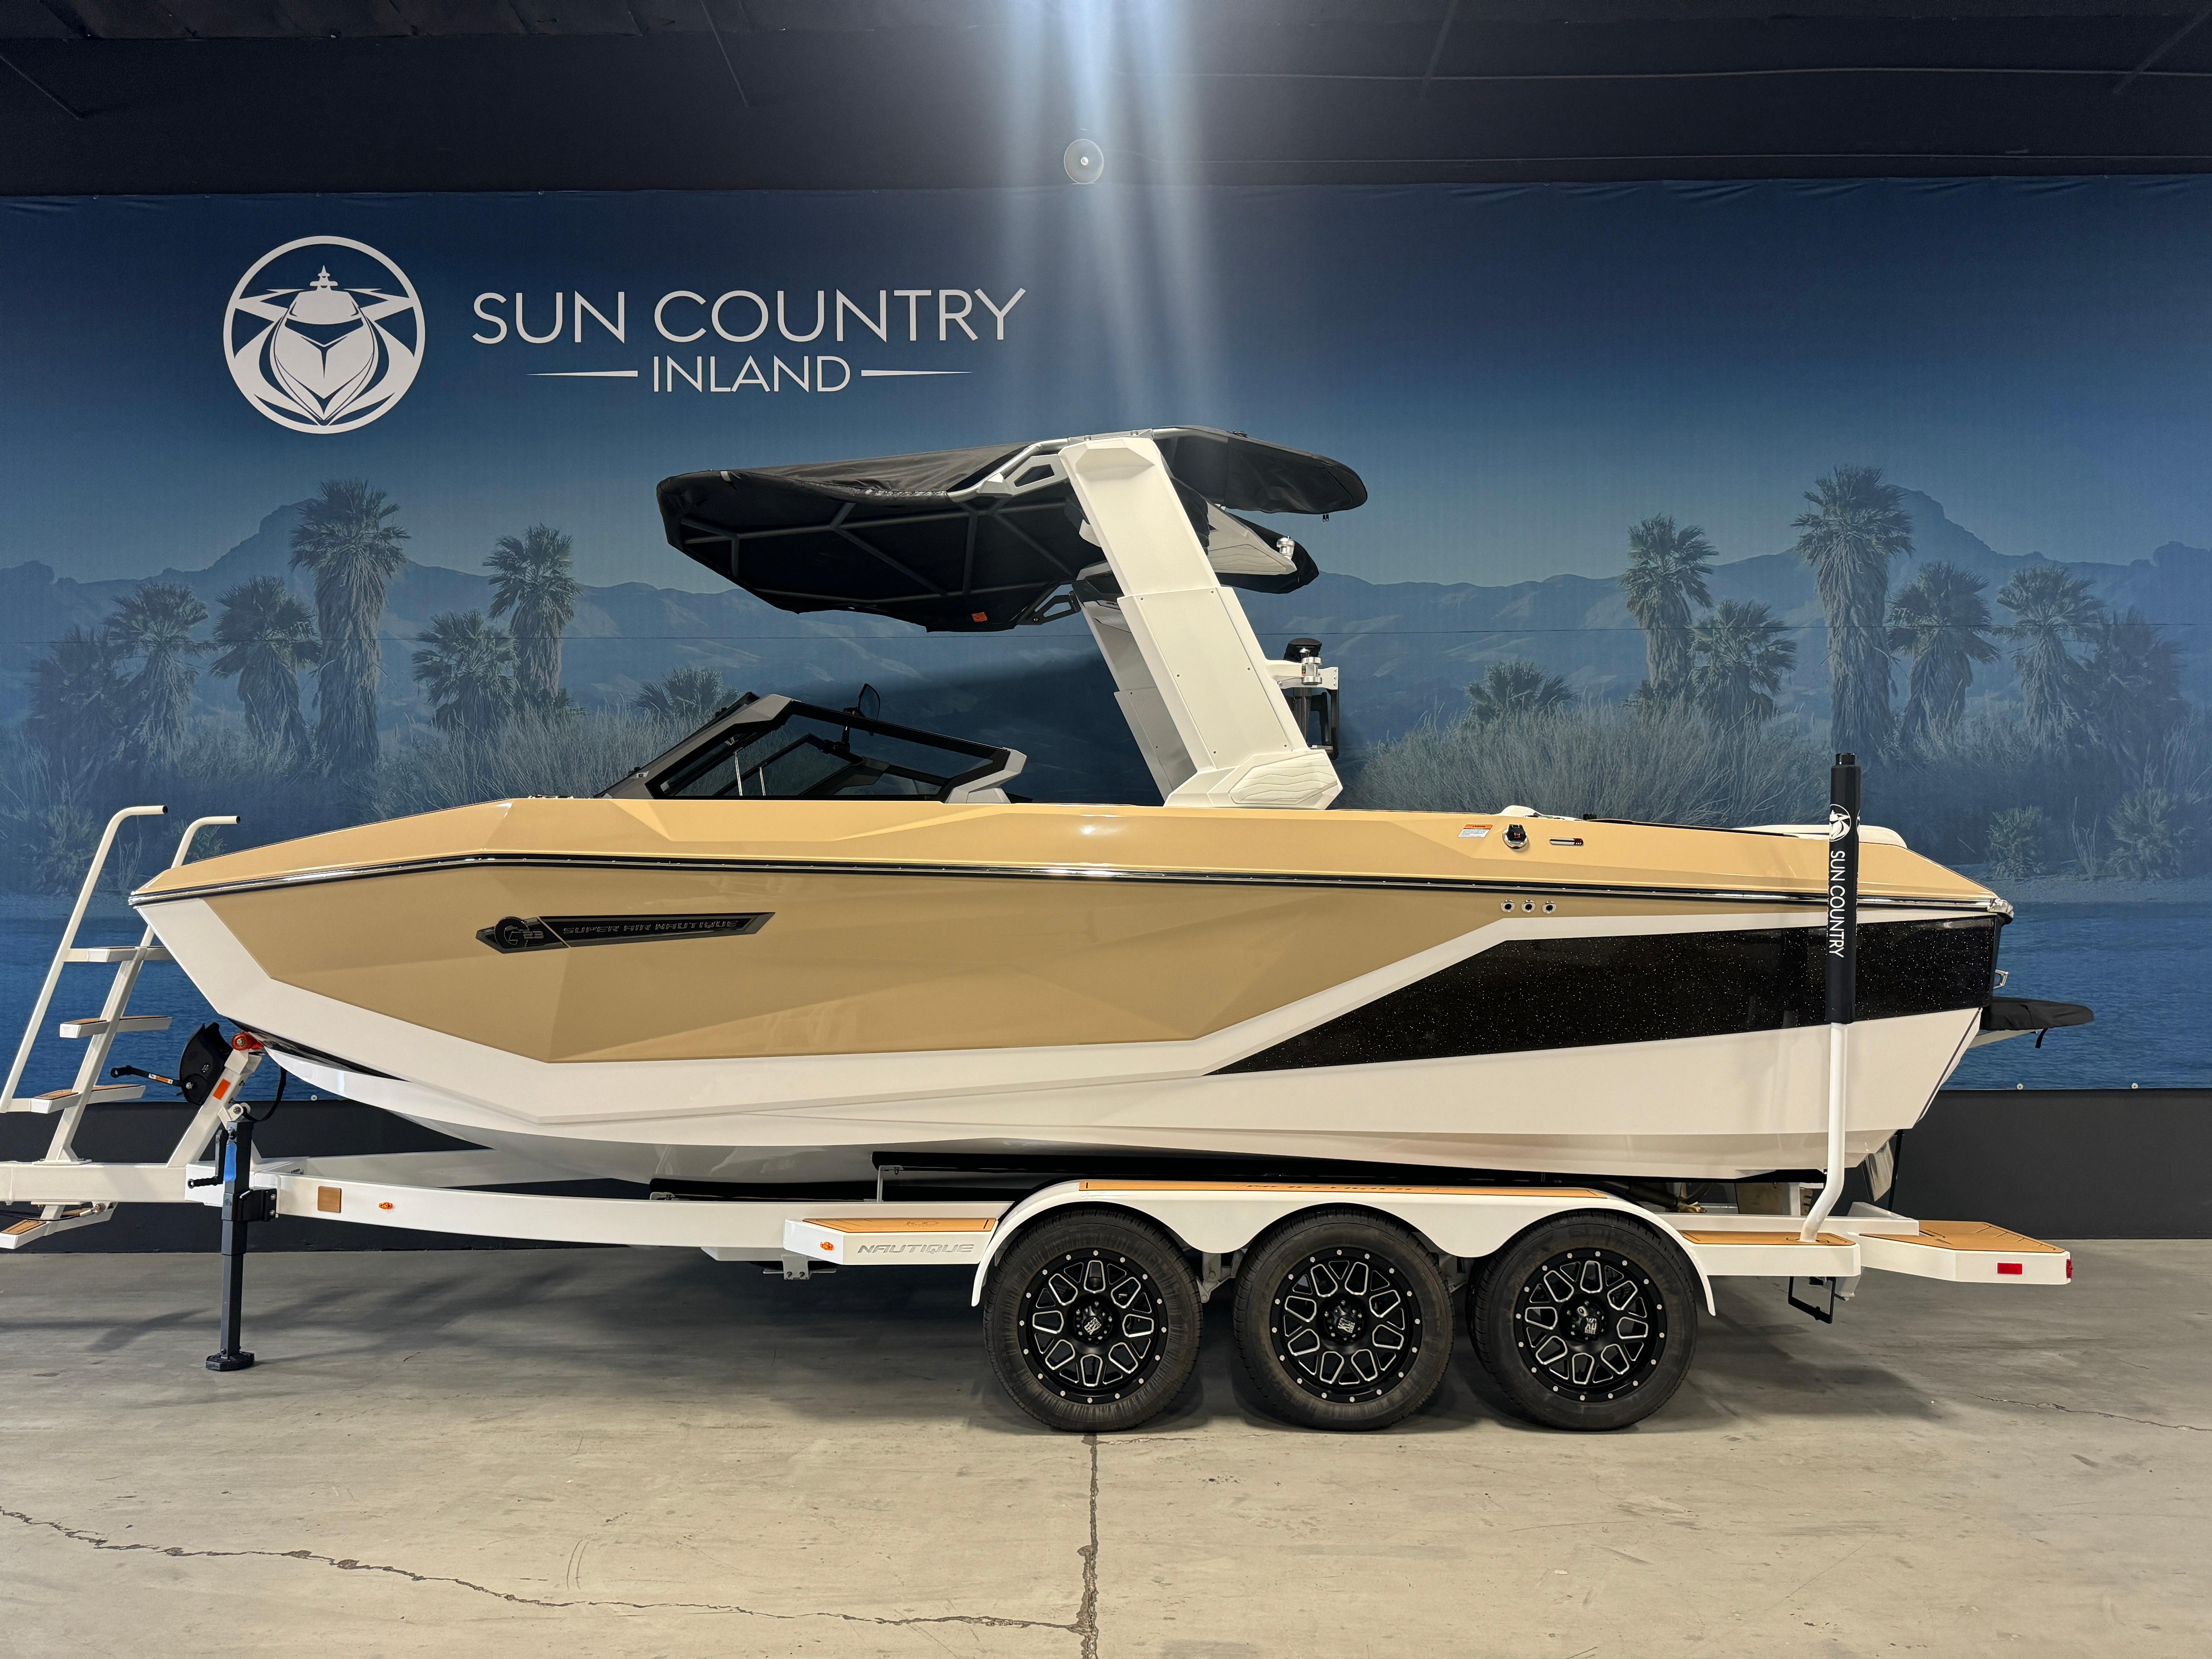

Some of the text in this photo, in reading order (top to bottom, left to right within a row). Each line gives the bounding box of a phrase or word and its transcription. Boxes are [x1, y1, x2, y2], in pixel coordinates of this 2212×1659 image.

[472, 288, 1026, 344] SUN COUNTRY
[654, 355, 850, 393] INLAND
[1829, 850, 1846, 958] SUN COUNTRY
[563, 926, 619, 934] SUPER
[655, 920, 738, 930] NAUTIQUE
[857, 1244, 974, 1254] NAUTIQUE
